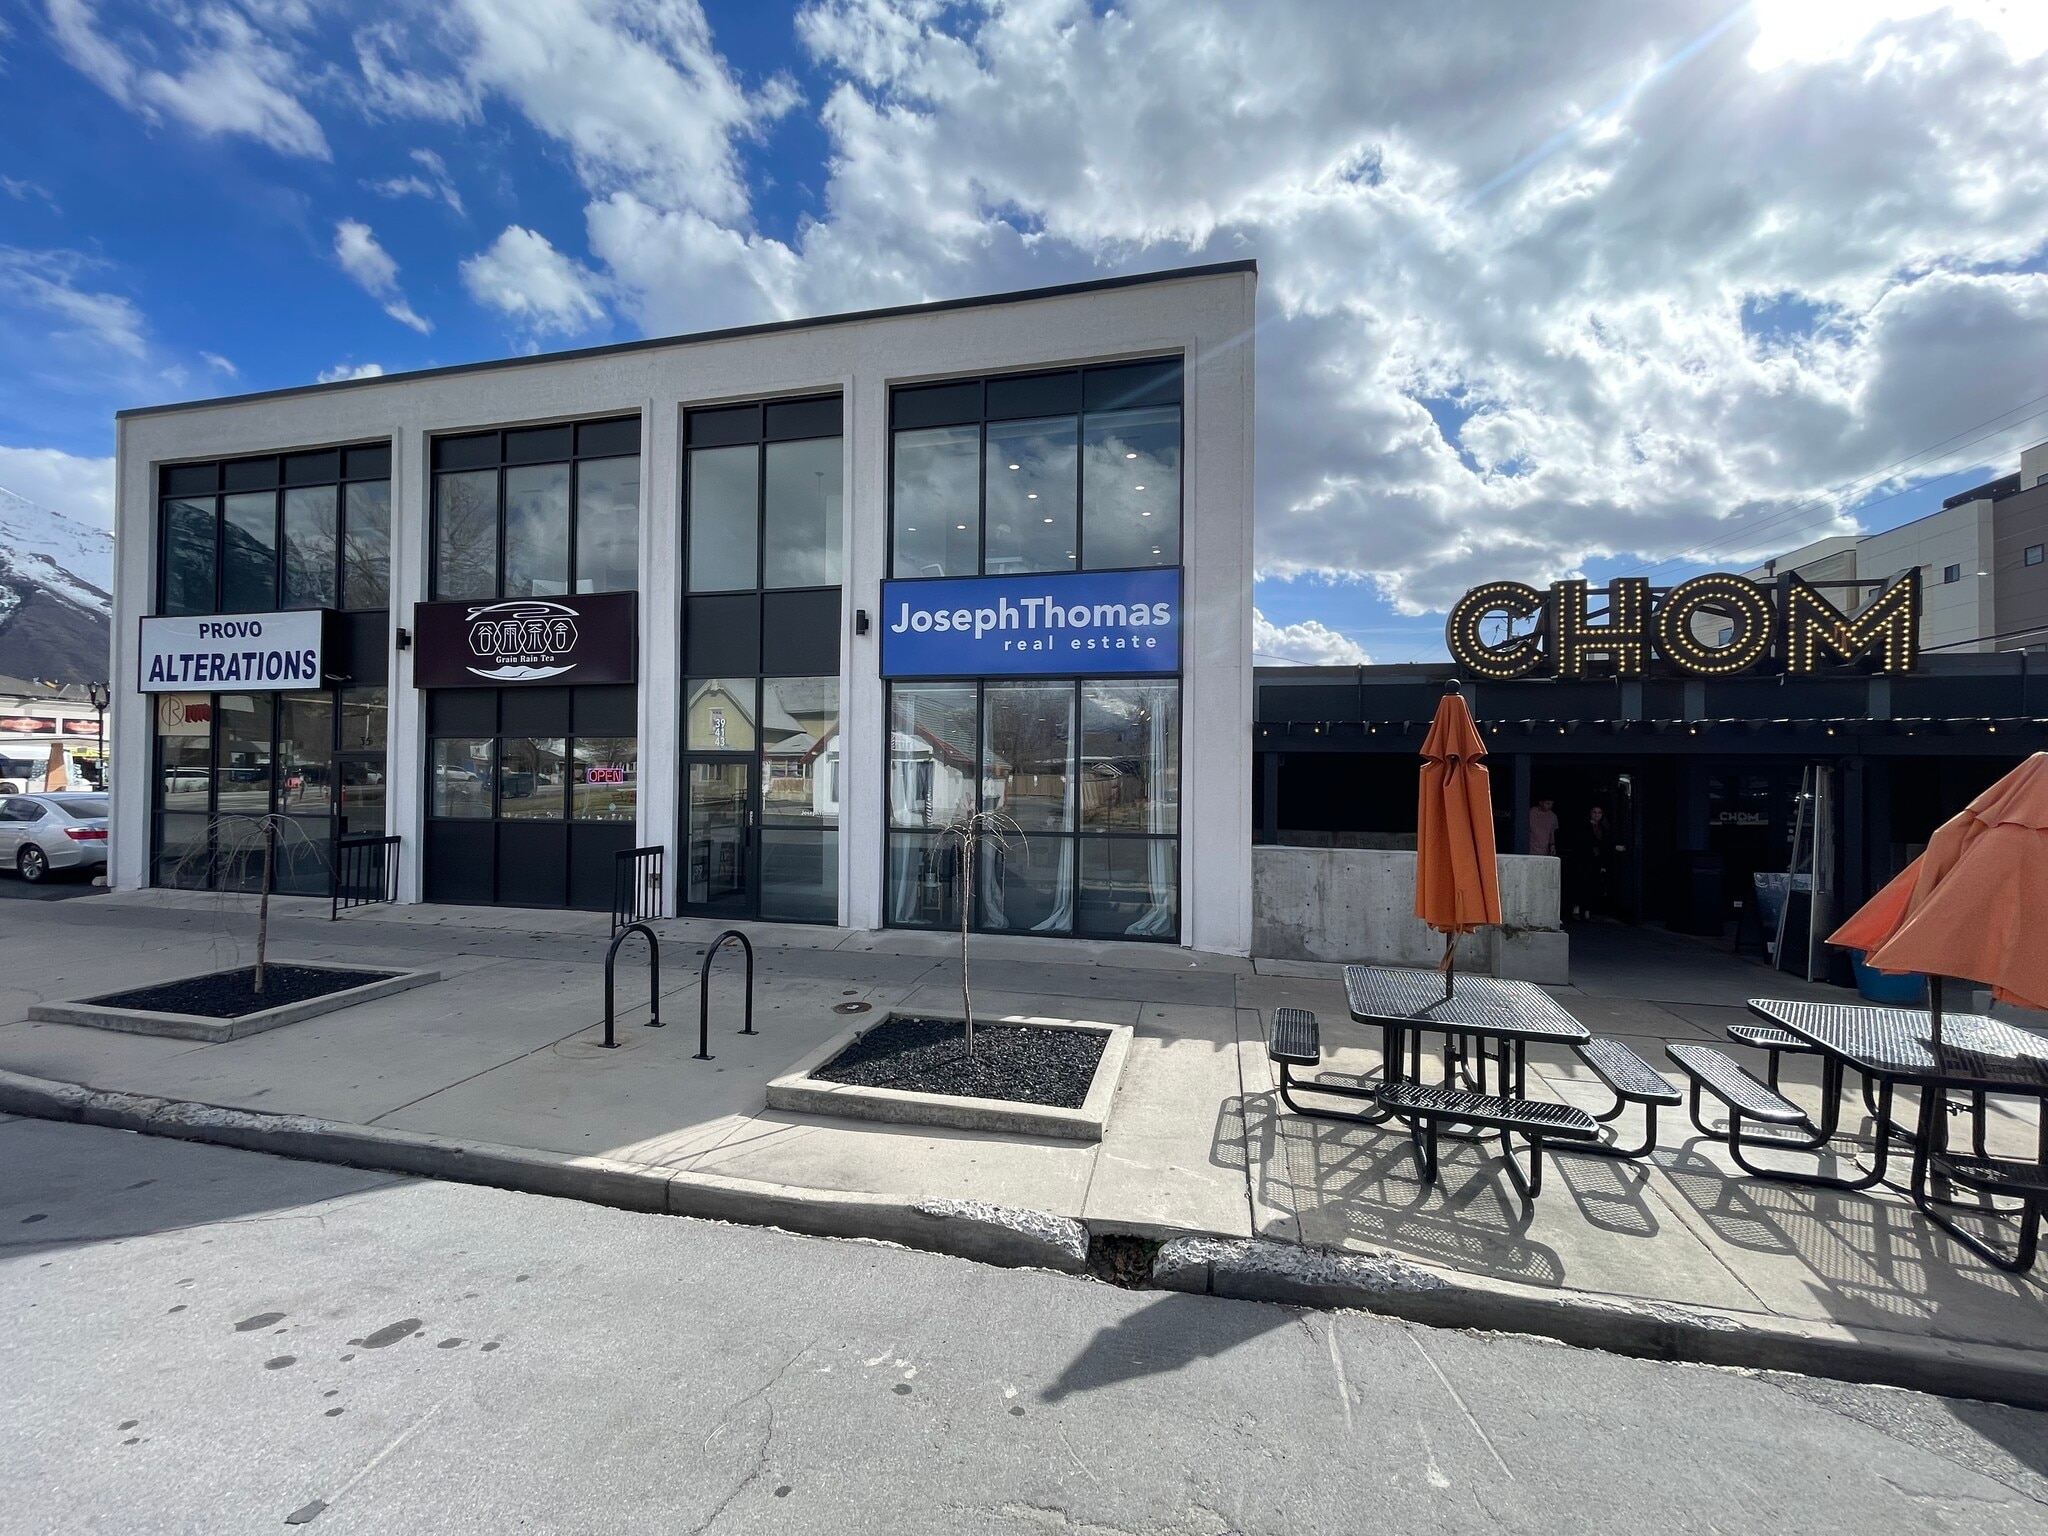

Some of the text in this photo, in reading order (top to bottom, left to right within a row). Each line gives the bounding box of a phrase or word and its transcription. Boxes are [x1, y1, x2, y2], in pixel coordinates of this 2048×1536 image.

[891, 596, 1171, 639] JosephThomas
[1446, 566, 1921, 679] CHOM
[199, 621, 262, 639] PROVO
[1004, 635, 1157, 651] real estate
[495, 654, 555, 664] Grain Rain Tea
[149, 650, 316, 682] ALTERATIONS
[715, 718, 726, 728] 39
[715, 728, 725, 737] 41
[715, 737, 725, 747] 43
[589, 770, 621, 782] OPEN
[1719, 811, 1760, 822] CHOM
